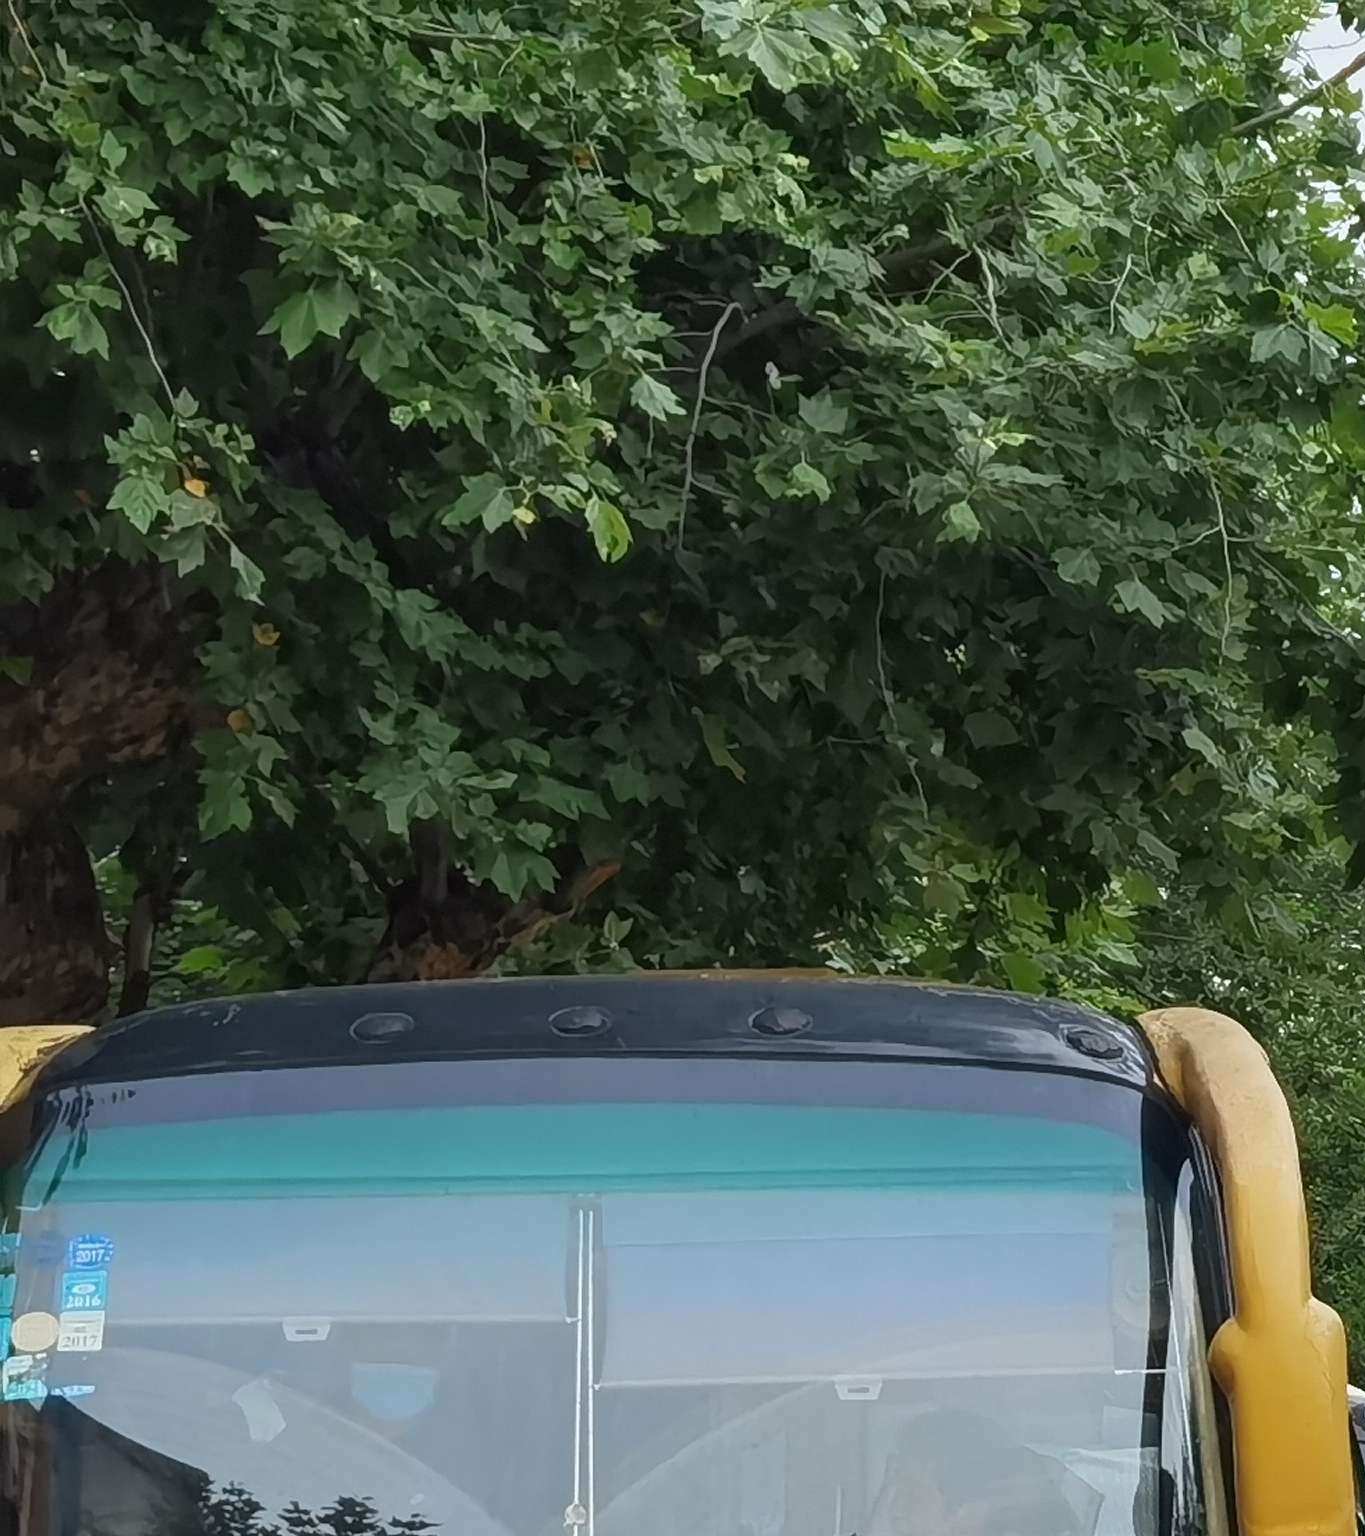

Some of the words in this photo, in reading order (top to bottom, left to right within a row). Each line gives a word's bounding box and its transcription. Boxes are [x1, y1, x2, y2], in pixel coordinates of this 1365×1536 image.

[75, 1249, 105, 1263] 2017
[66, 1295, 102, 1308] 2016
[62, 1335, 98, 1348] 2017
